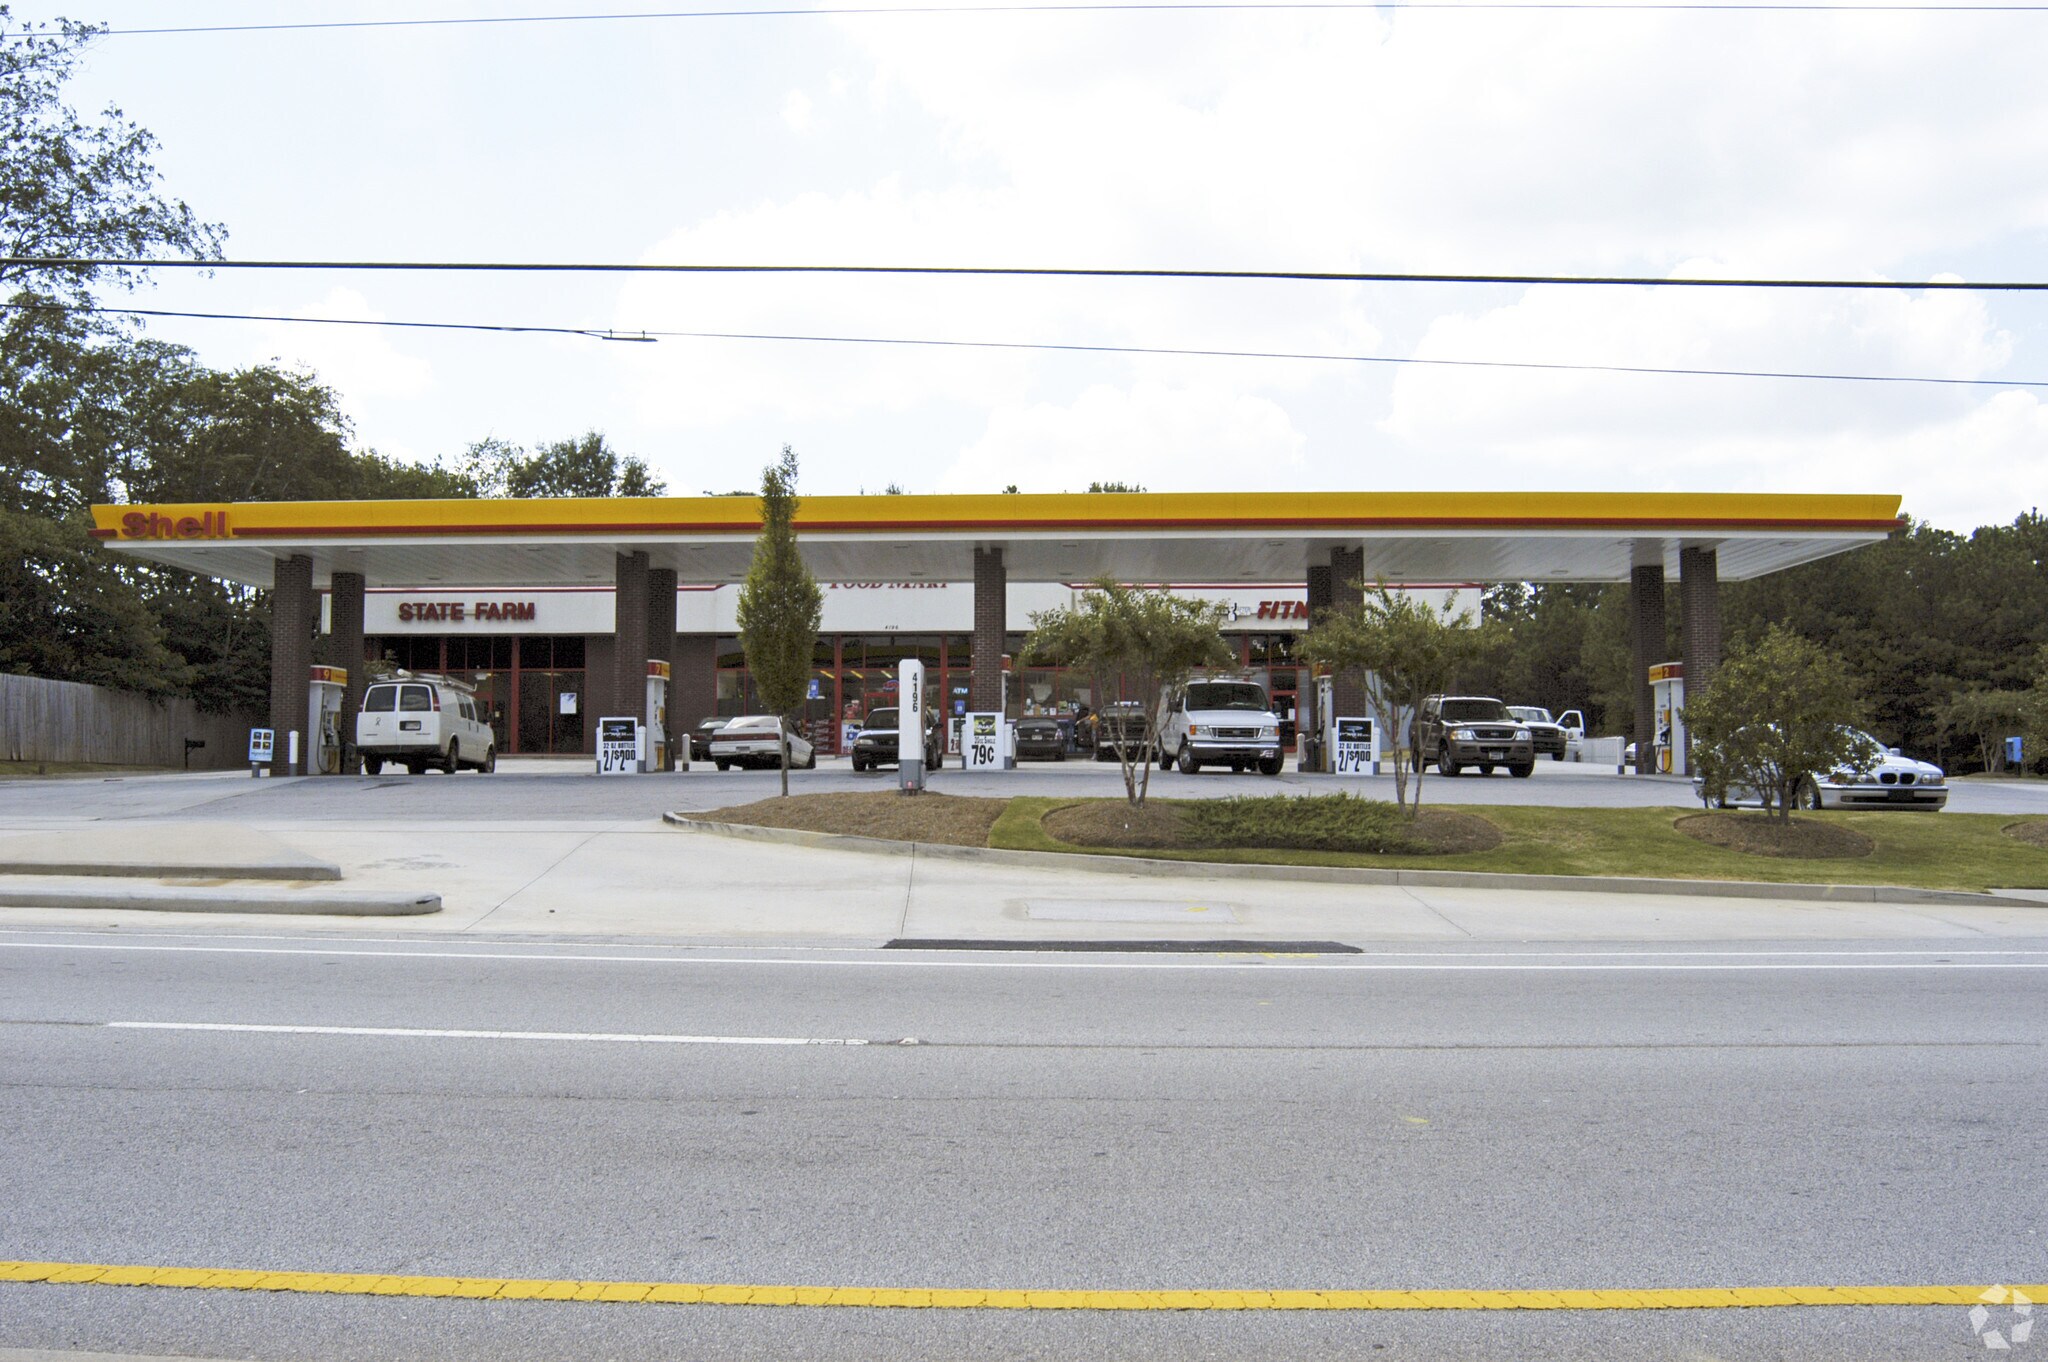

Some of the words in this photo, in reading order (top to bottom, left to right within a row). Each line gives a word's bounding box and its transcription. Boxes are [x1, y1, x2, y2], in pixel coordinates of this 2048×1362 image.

[122, 511, 226, 537] Shell
[399, 602, 465, 621] STATE
[475, 602, 536, 621] FARM
[324, 669, 330, 680] 9
[1664, 666, 1670, 678] 2
[952, 687, 969, 695] ATM
[971, 744, 995, 765] 79¢
